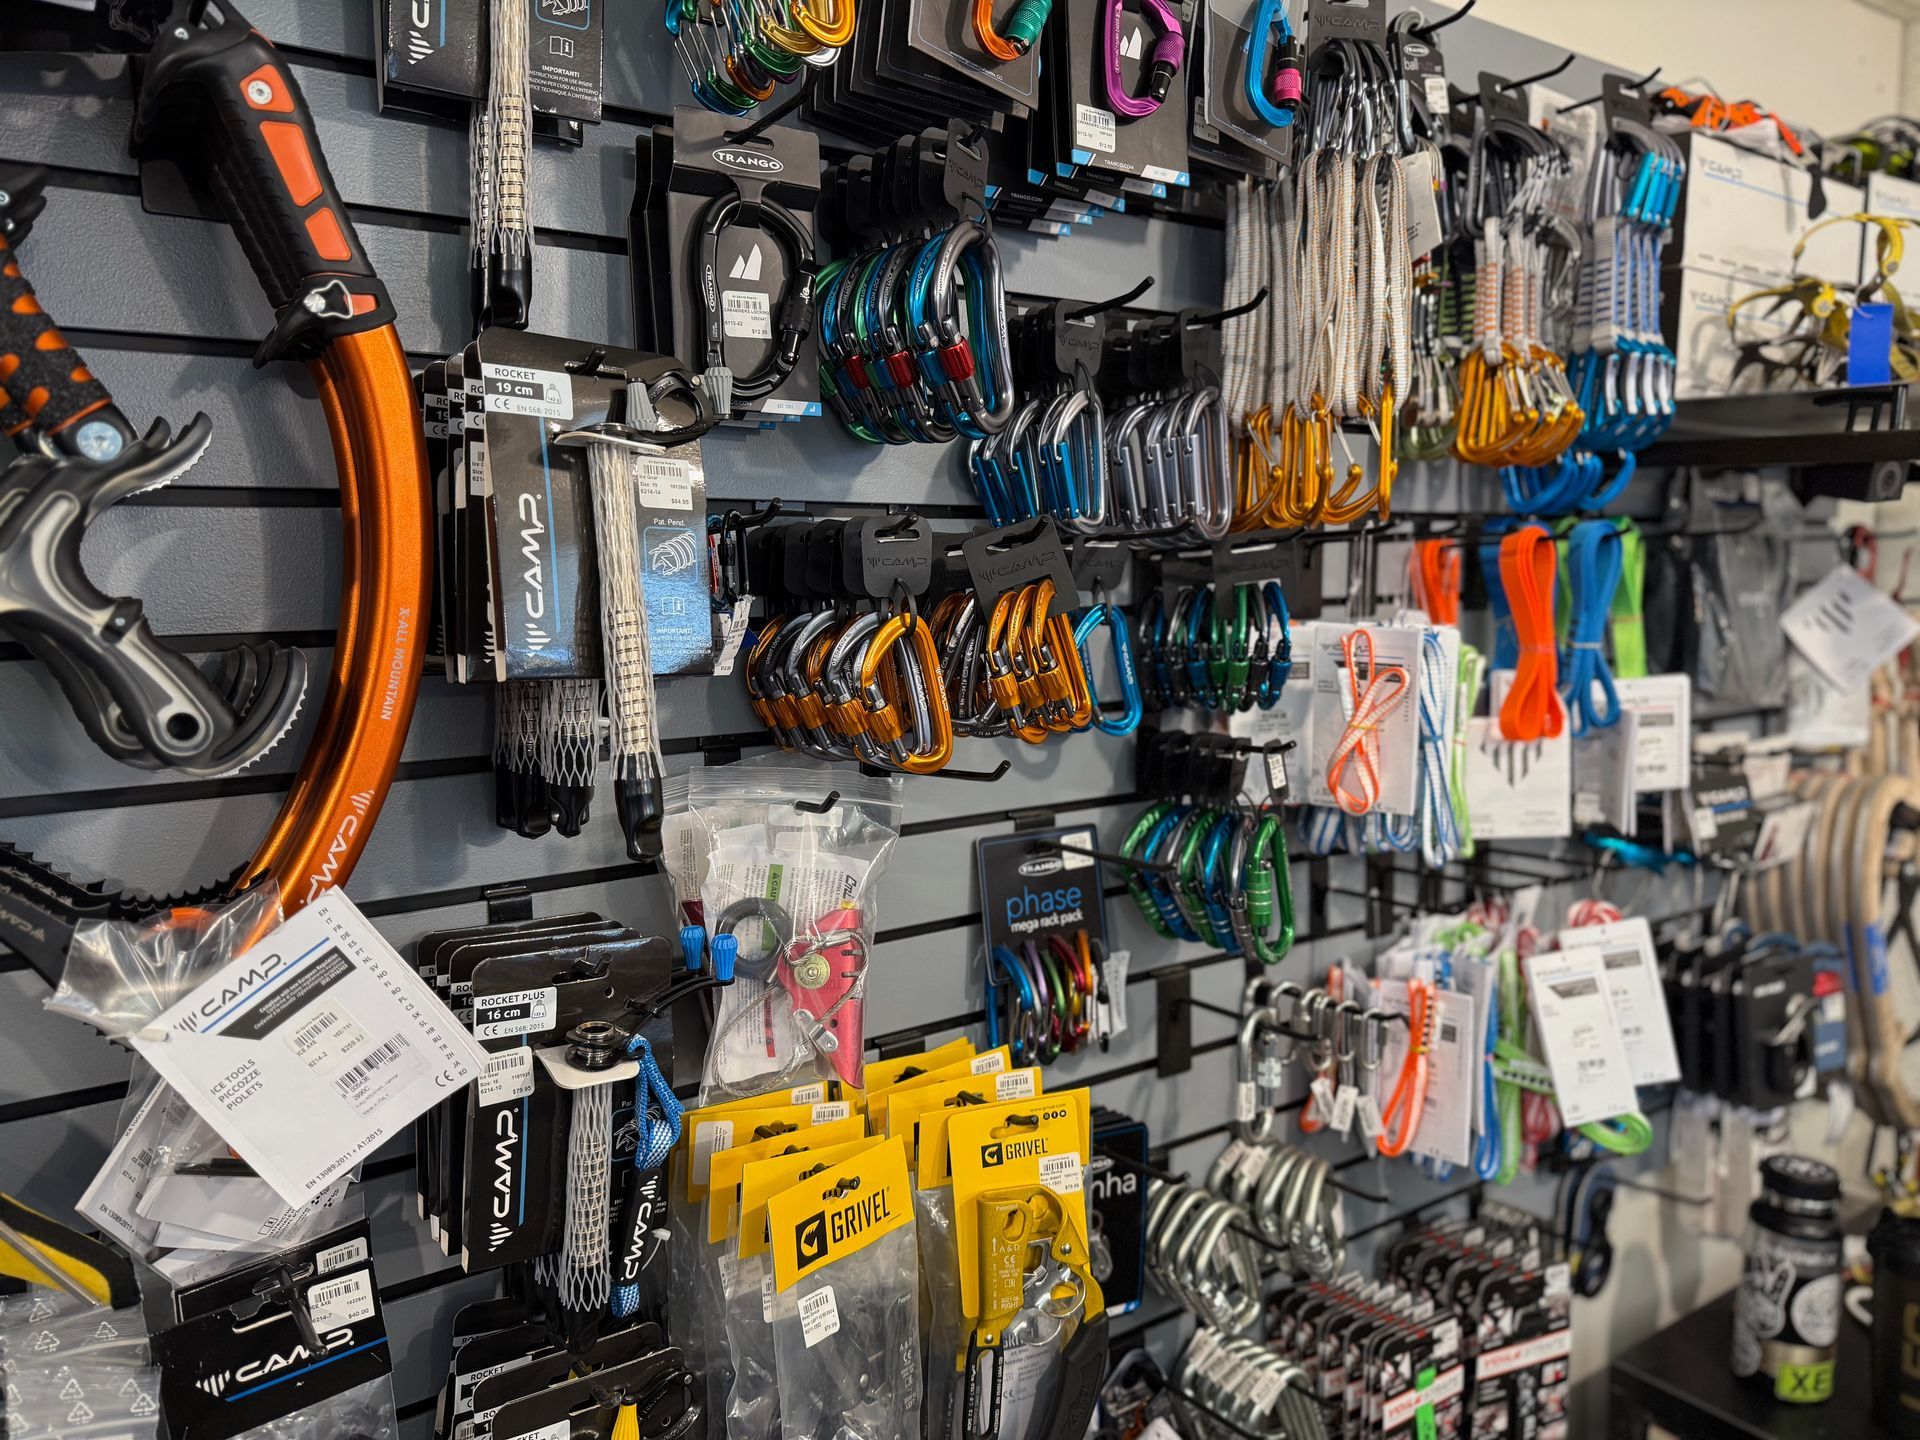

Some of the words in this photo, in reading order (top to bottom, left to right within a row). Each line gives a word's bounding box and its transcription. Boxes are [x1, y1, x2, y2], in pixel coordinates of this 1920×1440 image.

[542, 64, 580, 78] IMPORTANT!
[717, 151, 780, 170] TRANGO
[706, 272, 716, 307] TRANGO
[494, 367, 536, 381] ROCKET
[495, 381, 511, 393] 19
[513, 384, 533, 397] cm
[516, 404, 527, 413] EN
[527, 405, 542, 414] 568:
[544, 407, 561, 416] 2015
[667, 518, 685, 526] Pend.
[518, 493, 545, 619] CAMP
[998, 551, 1057, 577] CAMP
[397, 607, 411, 646] X-ALL
[1123, 653, 1134, 685] CAMP
[380, 648, 408, 721] MOUNTAIN
[916, 675, 928, 712] CAMP
[937, 675, 949, 713] CAMP
[318, 907, 329, 917] EN
[1007, 886, 1082, 926] phase
[325, 917, 334, 925] IT
[1011, 919, 1038, 933] mega
[1039, 914, 1060, 928] rack
[1060, 910, 1084, 928] pack
[333, 924, 343, 933] FR
[340, 931, 351, 941] DE
[348, 940, 358, 949] ES
[355, 947, 365, 957] PT
[362, 955, 373, 964] NL
[370, 962, 380, 972] SV
[377, 970, 388, 980] NO
[384, 980, 392, 988] FI
[391, 986, 402, 996] RO
[398, 995, 408, 1004] PL
[481, 994, 520, 1007] ROCKET
[522, 990, 546, 1002] PLUS
[404, 1003, 415, 1012] CS
[411, 1010, 422, 1020] SK
[487, 1009, 501, 1020] 16
[503, 1009, 521, 1018] cm
[418, 1019, 428, 1028] SL
[504, 1027, 514, 1035] EN
[514, 1024, 529, 1033] 568:
[529, 1022, 545, 1031] 2015
[425, 1026, 436, 1036] HR
[432, 1035, 442, 1044] RU
[296, 1047, 307, 1057] ICE
[306, 1040, 318, 1050] AXE
[439, 1042, 449, 1052] TR
[445, 1051, 455, 1060] ZH
[452, 1060, 461, 1069] JA
[210, 1079, 228, 1095] ICE
[226, 1058, 256, 1083] TOOLS
[458, 1068, 468, 1077] KO
[218, 1069, 262, 1104] PICCOZZE
[226, 1080, 264, 1111] PIOLETS
[1005, 1137, 1048, 1161] GRIVEL
[305, 1178, 318, 1190] EN
[316, 1154, 353, 1181] 13089:2011
[357, 1128, 384, 1152] A1:2015
[493, 1109, 518, 1218] CAMP
[99, 1203, 109, 1213] EN
[830, 1193, 891, 1244] GRIVEL
[625, 1202, 651, 1280] CAMP
[320, 1300, 332, 1308] AXE
[348, 1308, 369, 1319] $40.00
[236, 1329, 353, 1382] CAMP
